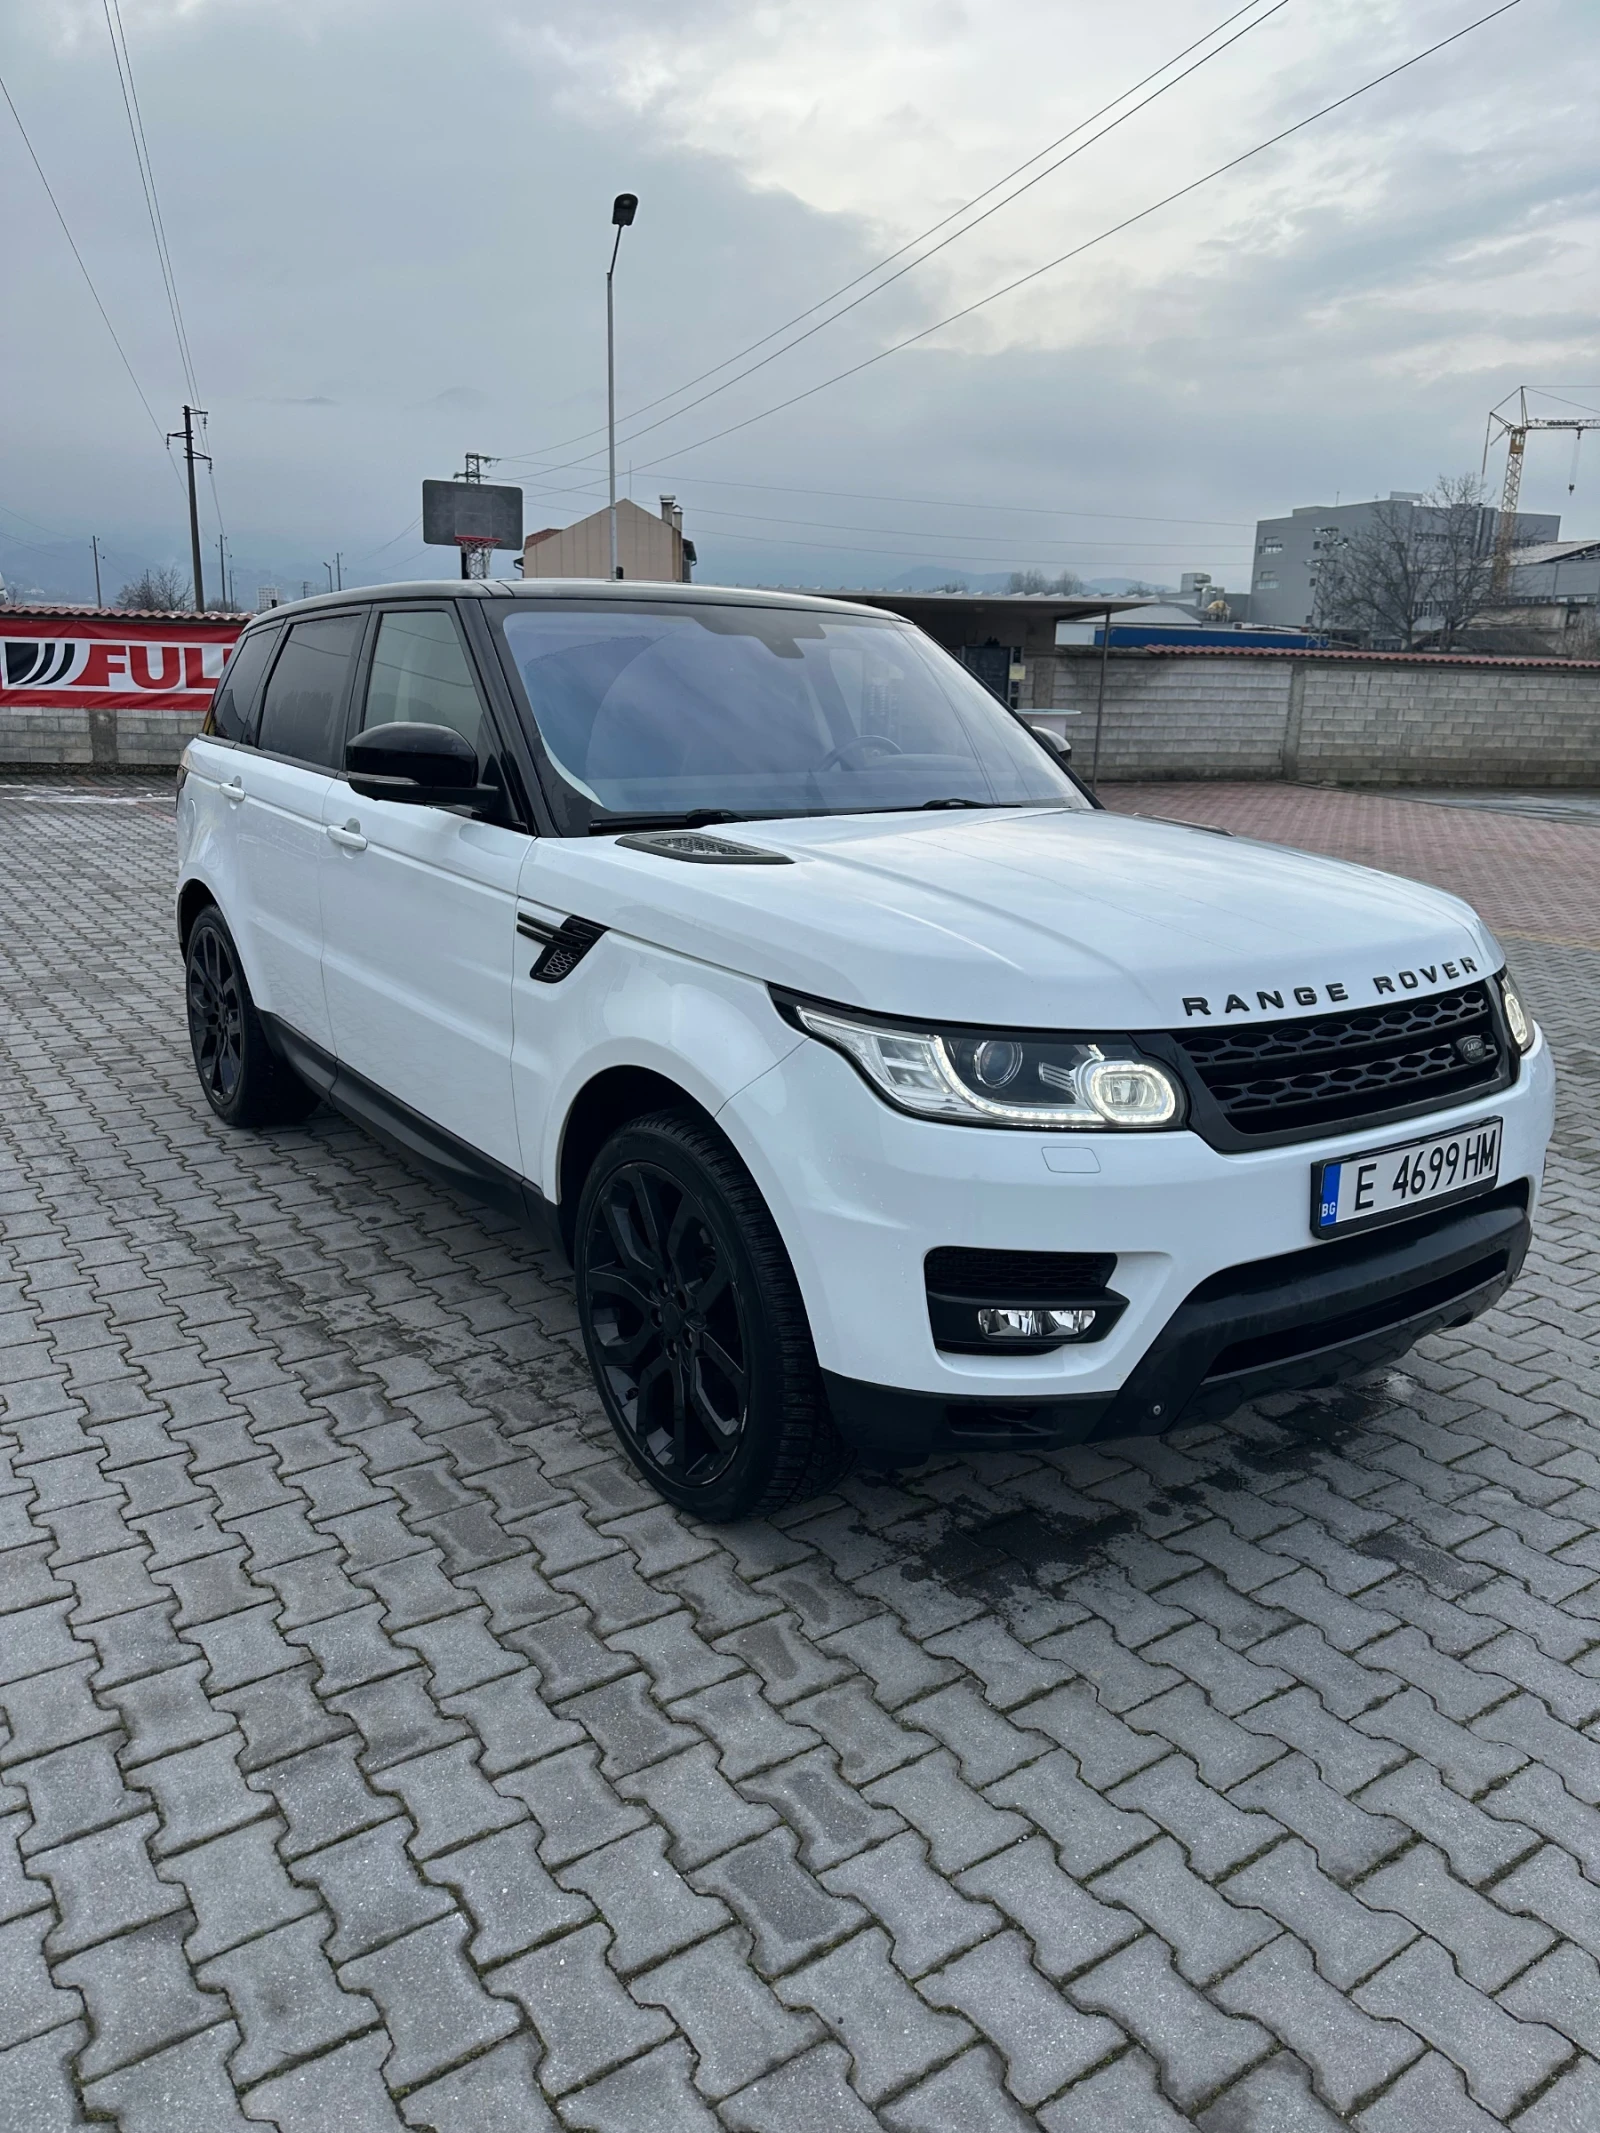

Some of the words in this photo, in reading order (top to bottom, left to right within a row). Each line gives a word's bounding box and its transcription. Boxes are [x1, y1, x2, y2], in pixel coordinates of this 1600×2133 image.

[66, 643, 232, 690] FUL
[1182, 982, 1349, 1017] RANGE
[1373, 956, 1478, 995] ROVER
[1354, 1162, 1377, 1211] E
[1392, 1141, 1460, 1199] 4699
[1462, 1128, 1497, 1181] HM
[1321, 1201, 1336, 1217] BG
